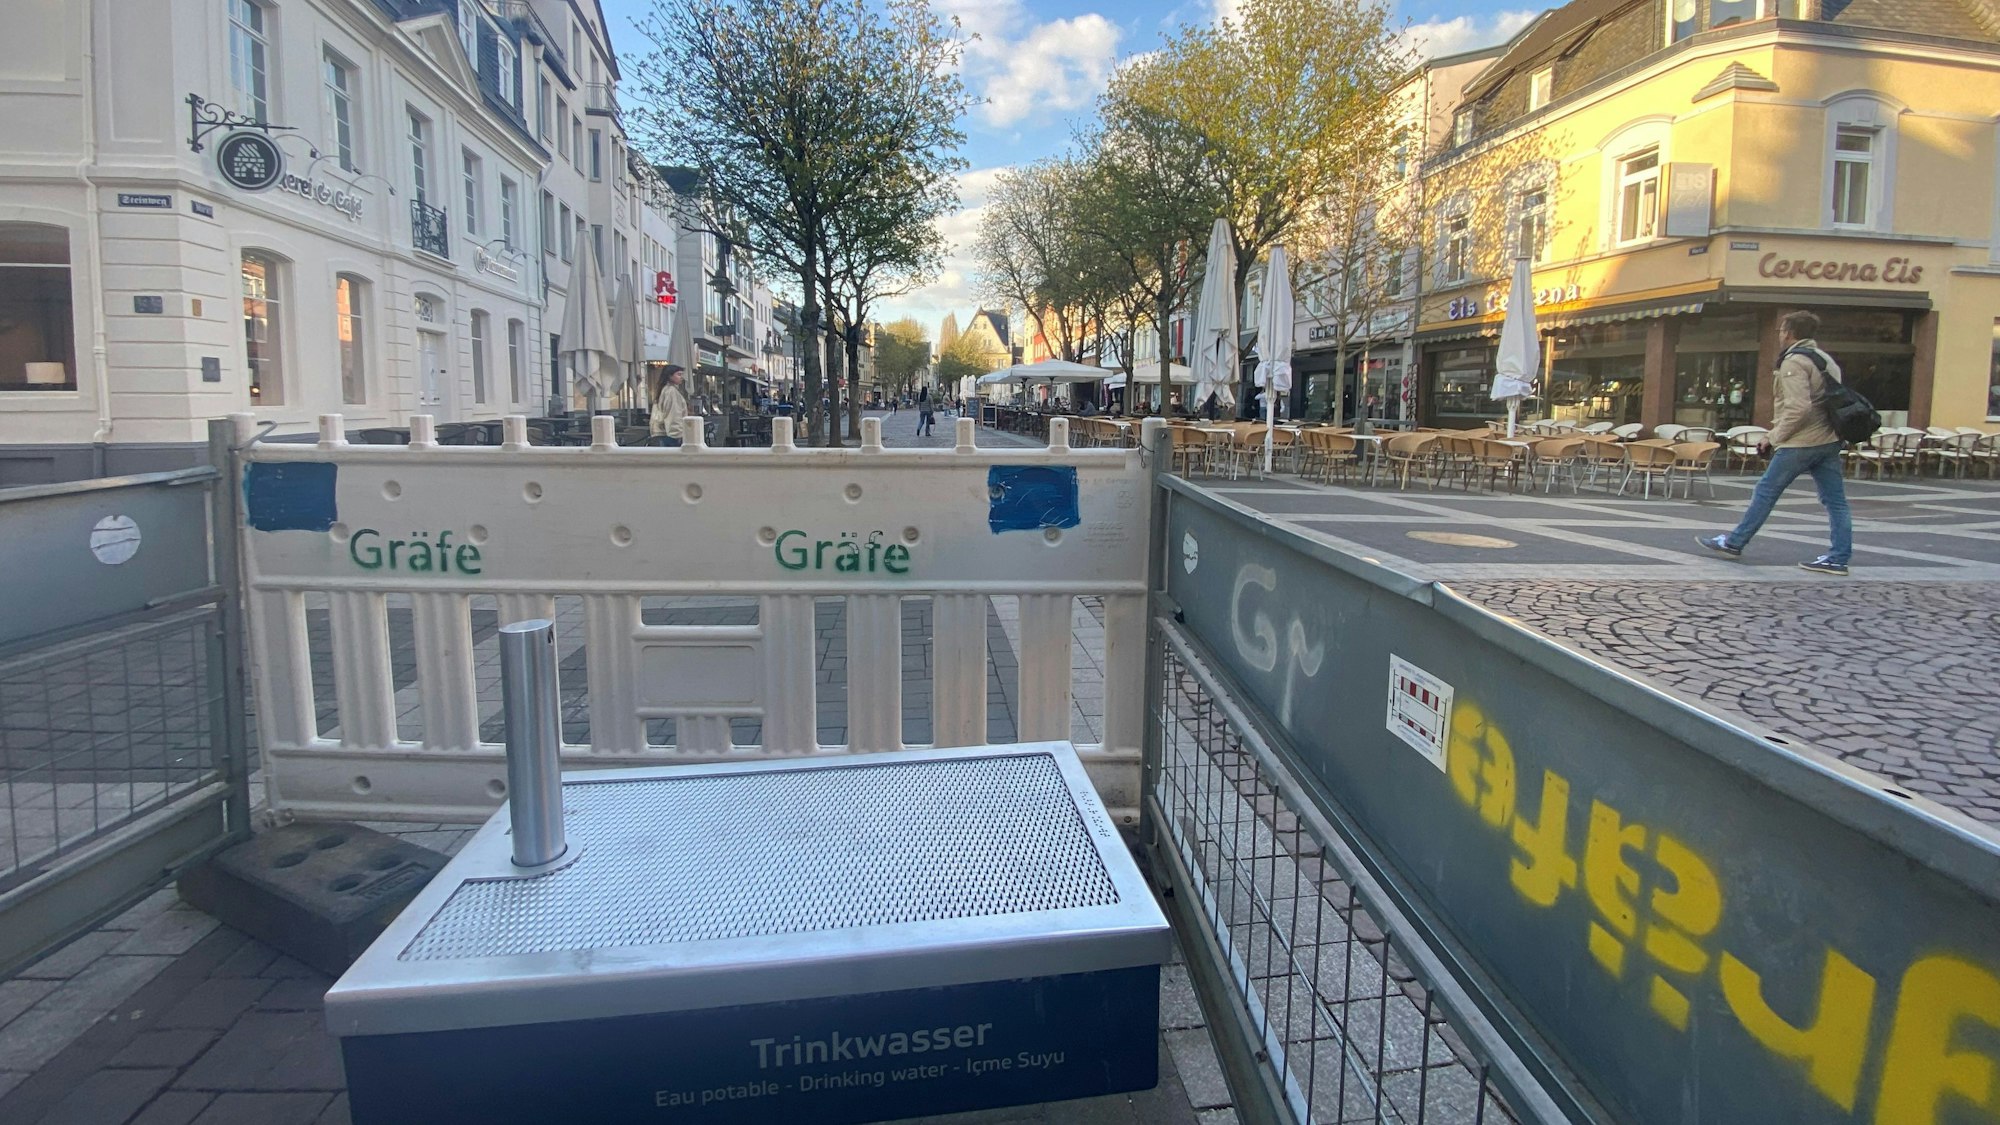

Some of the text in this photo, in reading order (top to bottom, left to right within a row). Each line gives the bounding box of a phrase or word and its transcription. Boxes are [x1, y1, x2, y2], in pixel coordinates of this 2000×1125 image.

[1758, 252, 1924, 284] Cercena Eis
[1448, 283, 1581, 320] Eis Ceena
[350, 528, 482, 575] Gräfe
[775, 529, 910, 574] Gräfe
[750, 1022, 993, 1068] Trinkwasser
[656, 1090, 695, 1107] Eau
[702, 1080, 779, 1106] potable
[801, 1070, 885, 1092] Drinking
[890, 1063, 948, 1081] water
[967, 1055, 1012, 1077] Içme
[1018, 1050, 1065, 1070] Suyu
